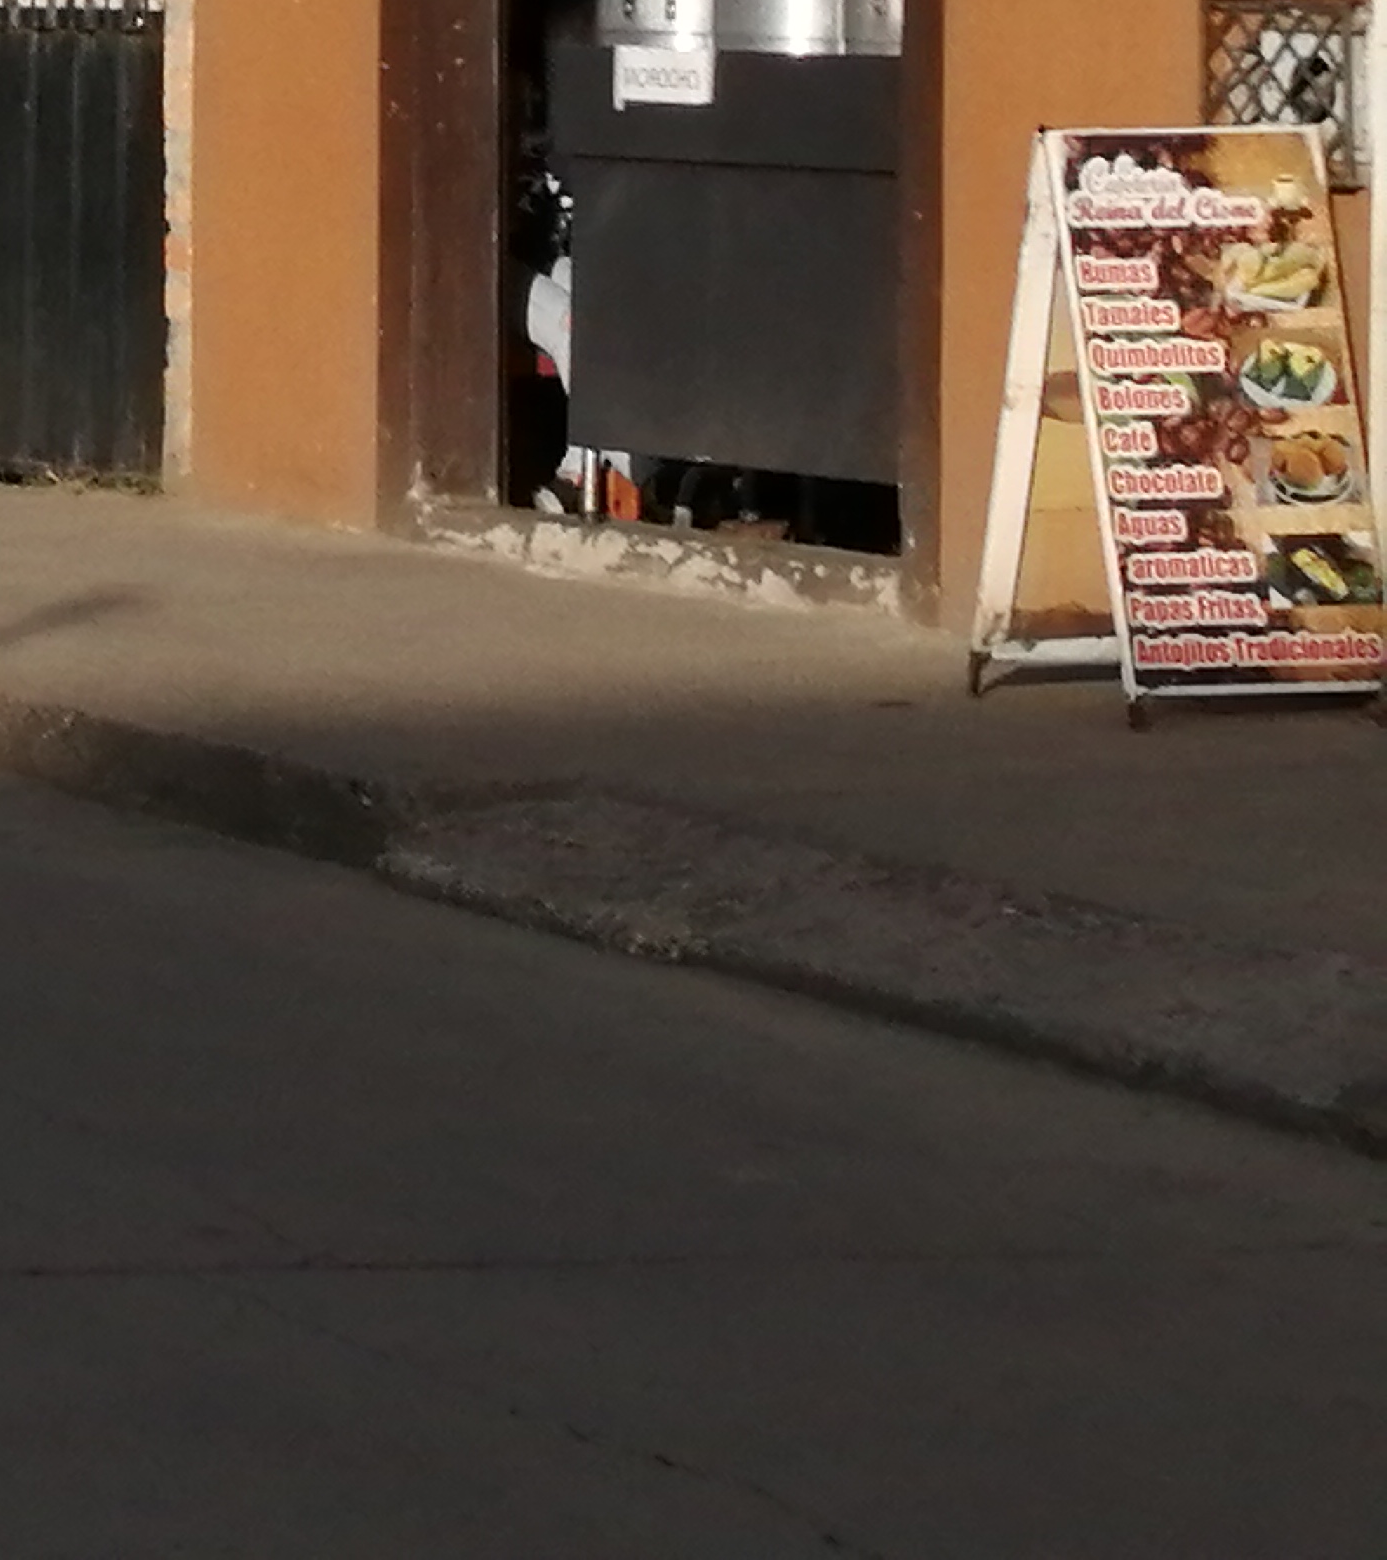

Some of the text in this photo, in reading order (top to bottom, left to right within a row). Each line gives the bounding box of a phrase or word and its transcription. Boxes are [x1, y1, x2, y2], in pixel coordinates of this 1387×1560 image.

[1151, 195, 1187, 221] del
[1084, 300, 1174, 326] Tamales
[1091, 343, 1221, 370] Quimbolitos
[1096, 385, 1187, 411] Bolones
[1110, 469, 1218, 494] Chocolate
[1117, 513, 1182, 539] Aguas
[1130, 597, 1193, 623] Papas
[1137, 636, 1379, 666] Antojitos Tradicionales
